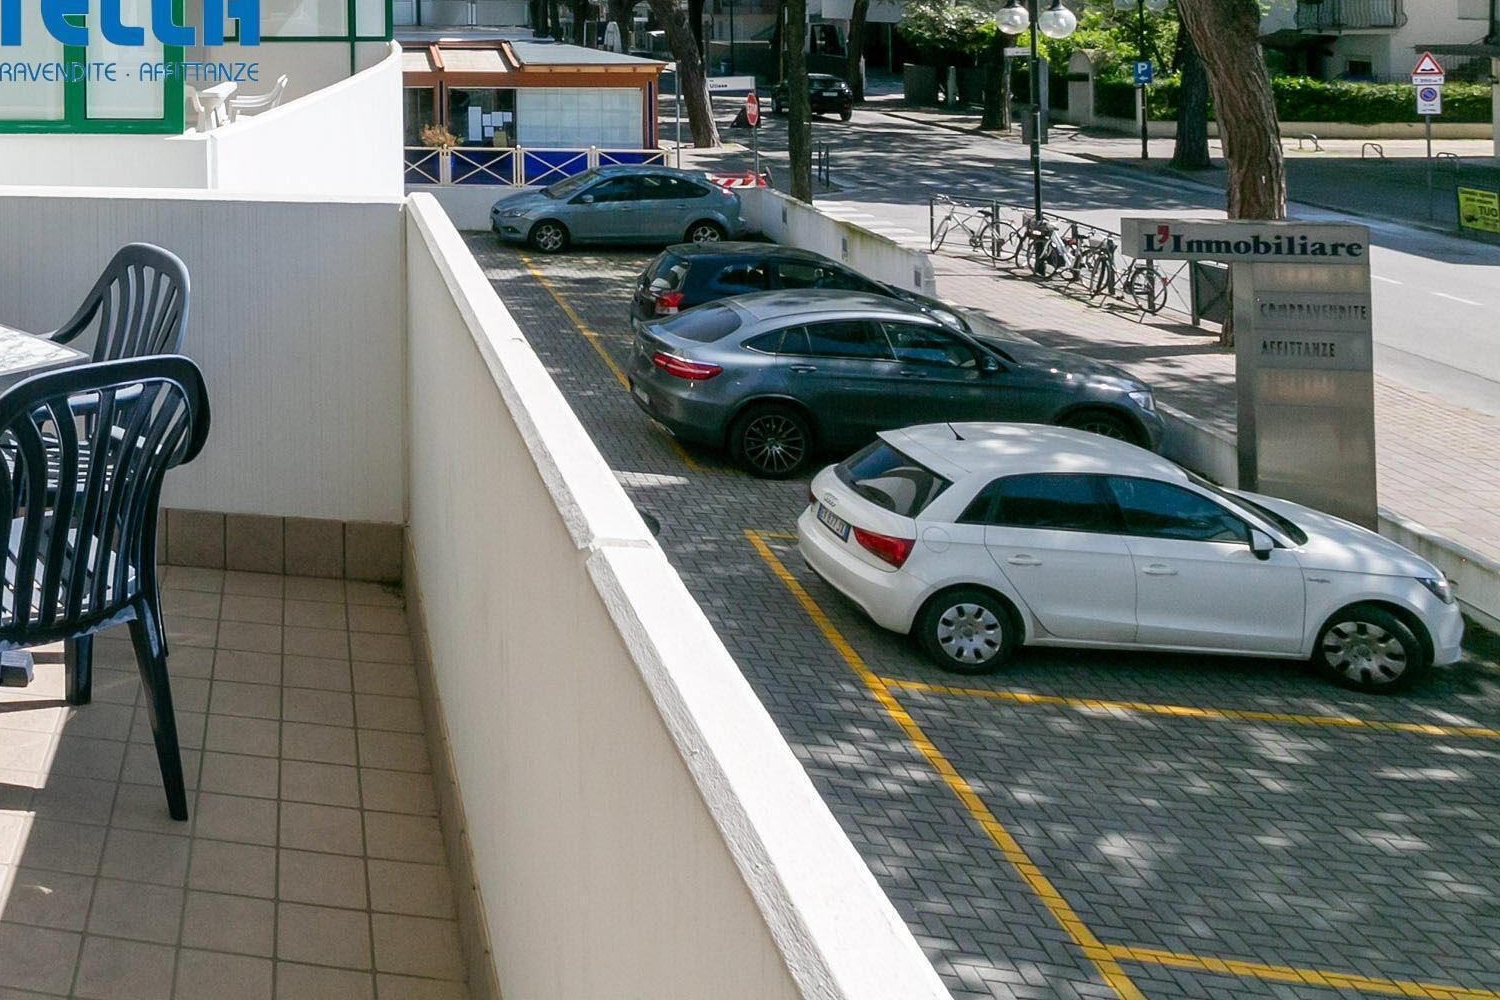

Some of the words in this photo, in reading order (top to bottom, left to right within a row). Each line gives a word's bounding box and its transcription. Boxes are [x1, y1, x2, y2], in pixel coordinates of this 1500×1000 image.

[1137, 62, 1148, 74] P
[1143, 225, 1363, 258] L'Immobiliare
[1261, 340, 1336, 358] AFFITTANZE
